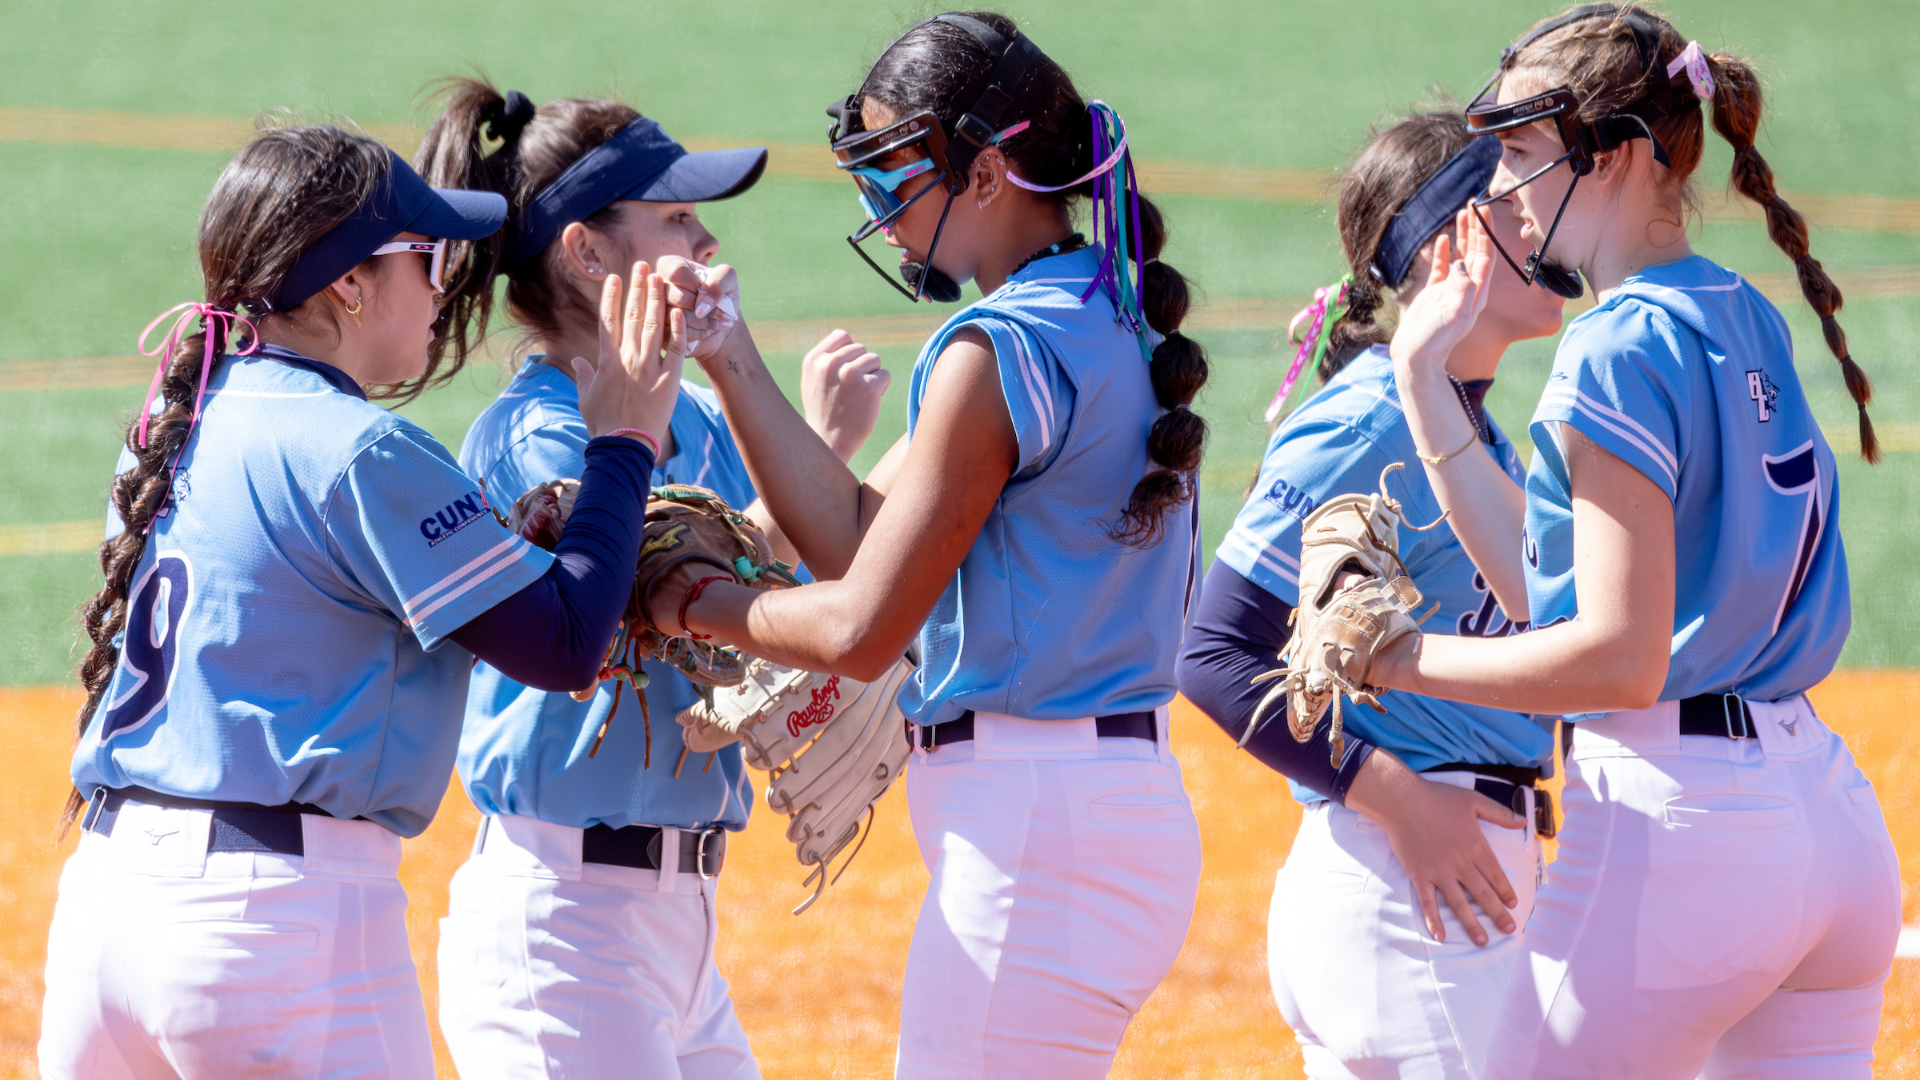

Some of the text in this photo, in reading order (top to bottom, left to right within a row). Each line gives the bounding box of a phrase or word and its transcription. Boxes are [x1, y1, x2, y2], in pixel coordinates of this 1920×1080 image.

[1270, 479, 1320, 516] CUN
[430, 508, 488, 547] ATHLETIC CONFERENCE
[100, 550, 194, 748] 9
